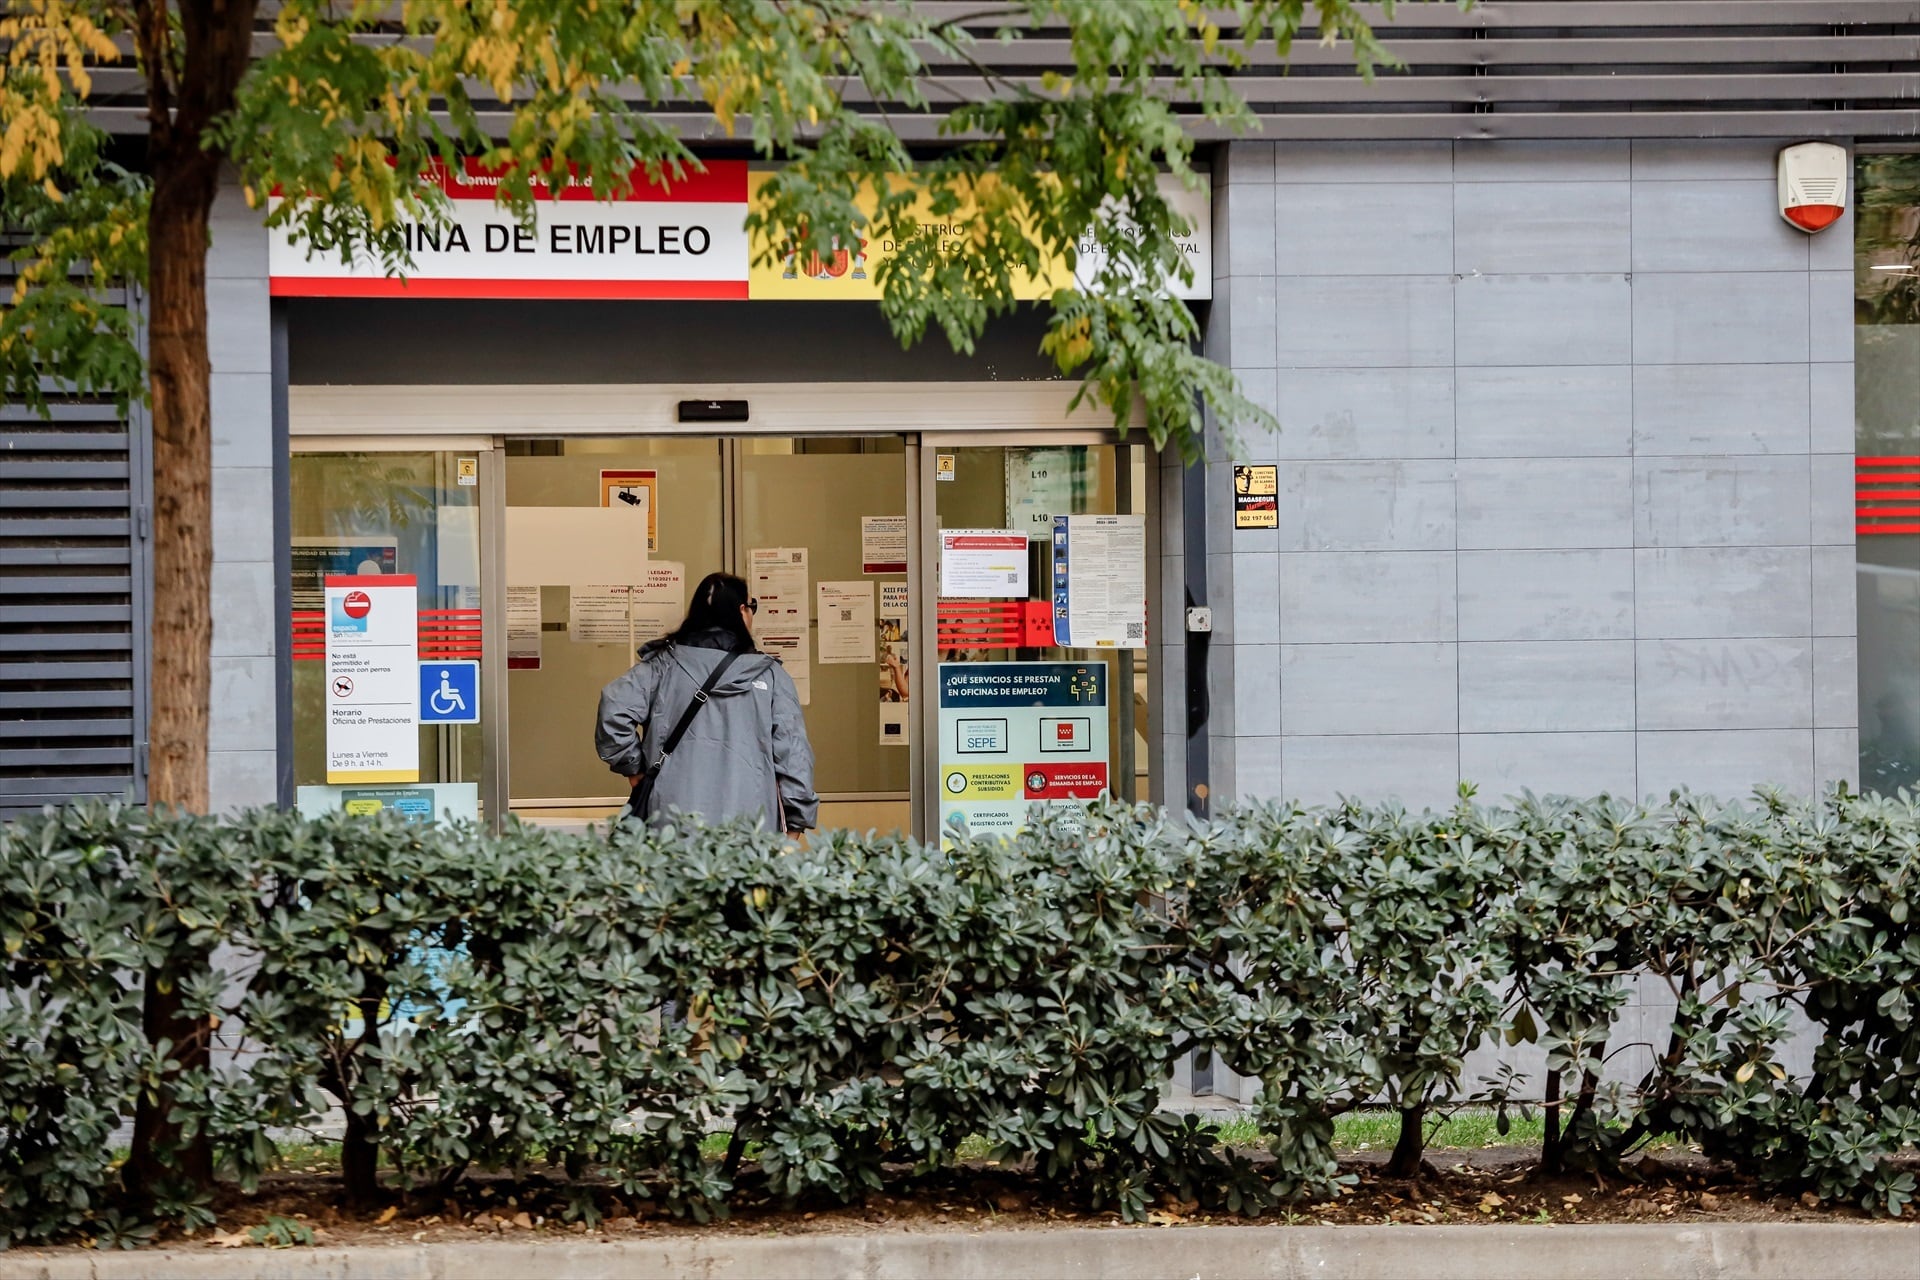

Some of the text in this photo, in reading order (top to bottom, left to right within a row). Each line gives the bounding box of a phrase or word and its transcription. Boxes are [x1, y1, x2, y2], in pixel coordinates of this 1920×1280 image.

[485, 223, 536, 254] DE
[550, 225, 711, 256] EMPLEO
[1081, 243, 1097, 254] DE
[1031, 470, 1048, 479] L10
[1032, 513, 1048, 522] L10
[946, 675, 1061, 687] ¿QUÉ SERVICIOS SE PRESTAN
[948, 687, 1048, 696] EN OFICINAS DE EMPLEO?
[332, 717, 356, 725] Oficina
[368, 717, 411, 725] Prestaciones
[967, 737, 997, 748] SEPE
